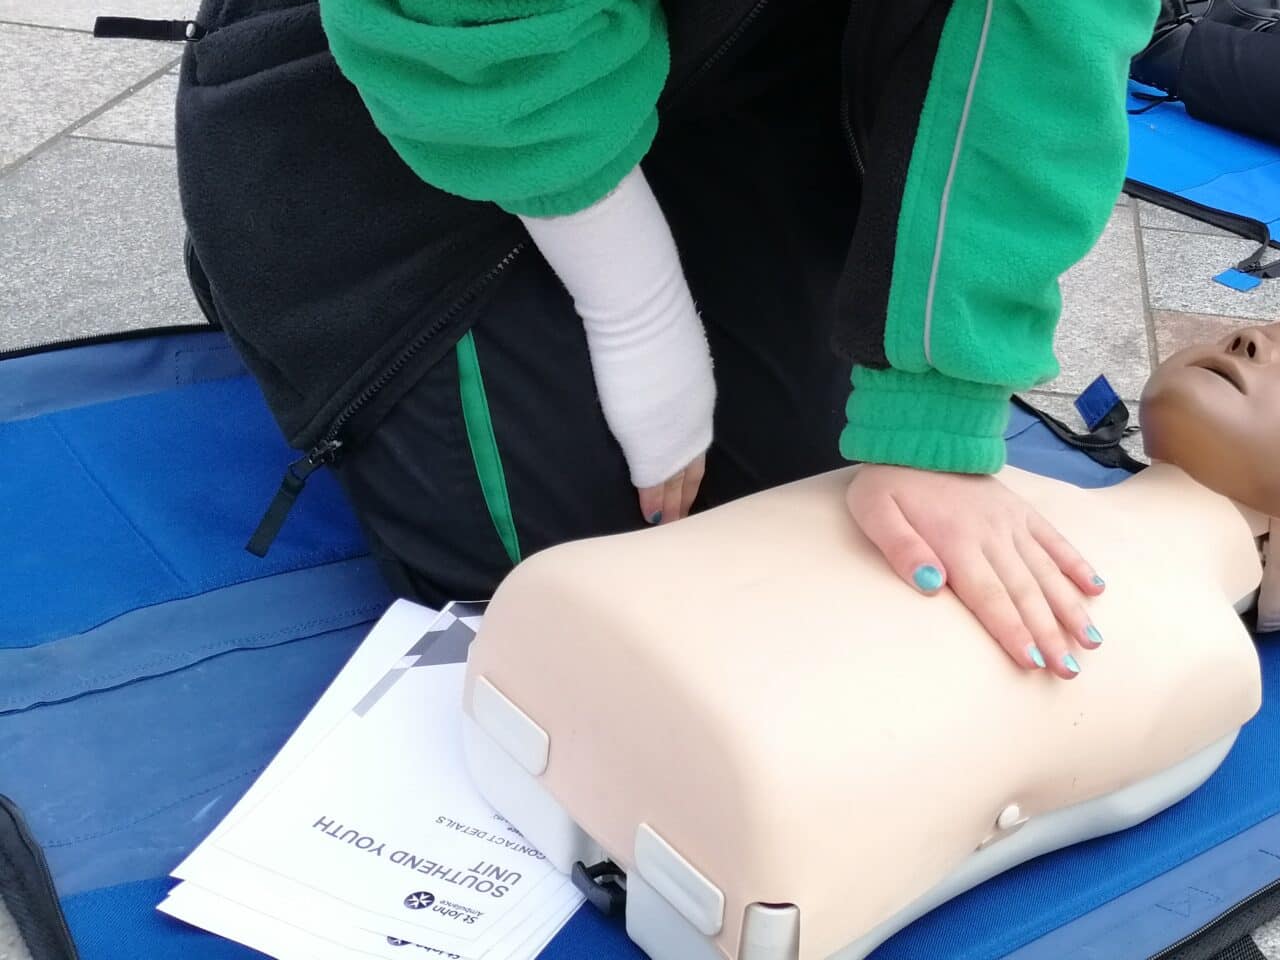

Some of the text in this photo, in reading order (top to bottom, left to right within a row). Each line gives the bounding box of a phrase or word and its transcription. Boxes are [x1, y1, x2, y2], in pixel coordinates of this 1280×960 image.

[435, 815, 489, 840] DETAILS
[312, 815, 509, 898] SOUTHEND YOUTH
[486, 834, 547, 861] CONTACT
[468, 861, 522, 886] UNIT
[432, 905, 478, 925] St John
[439, 900, 484, 917] Ambulance
